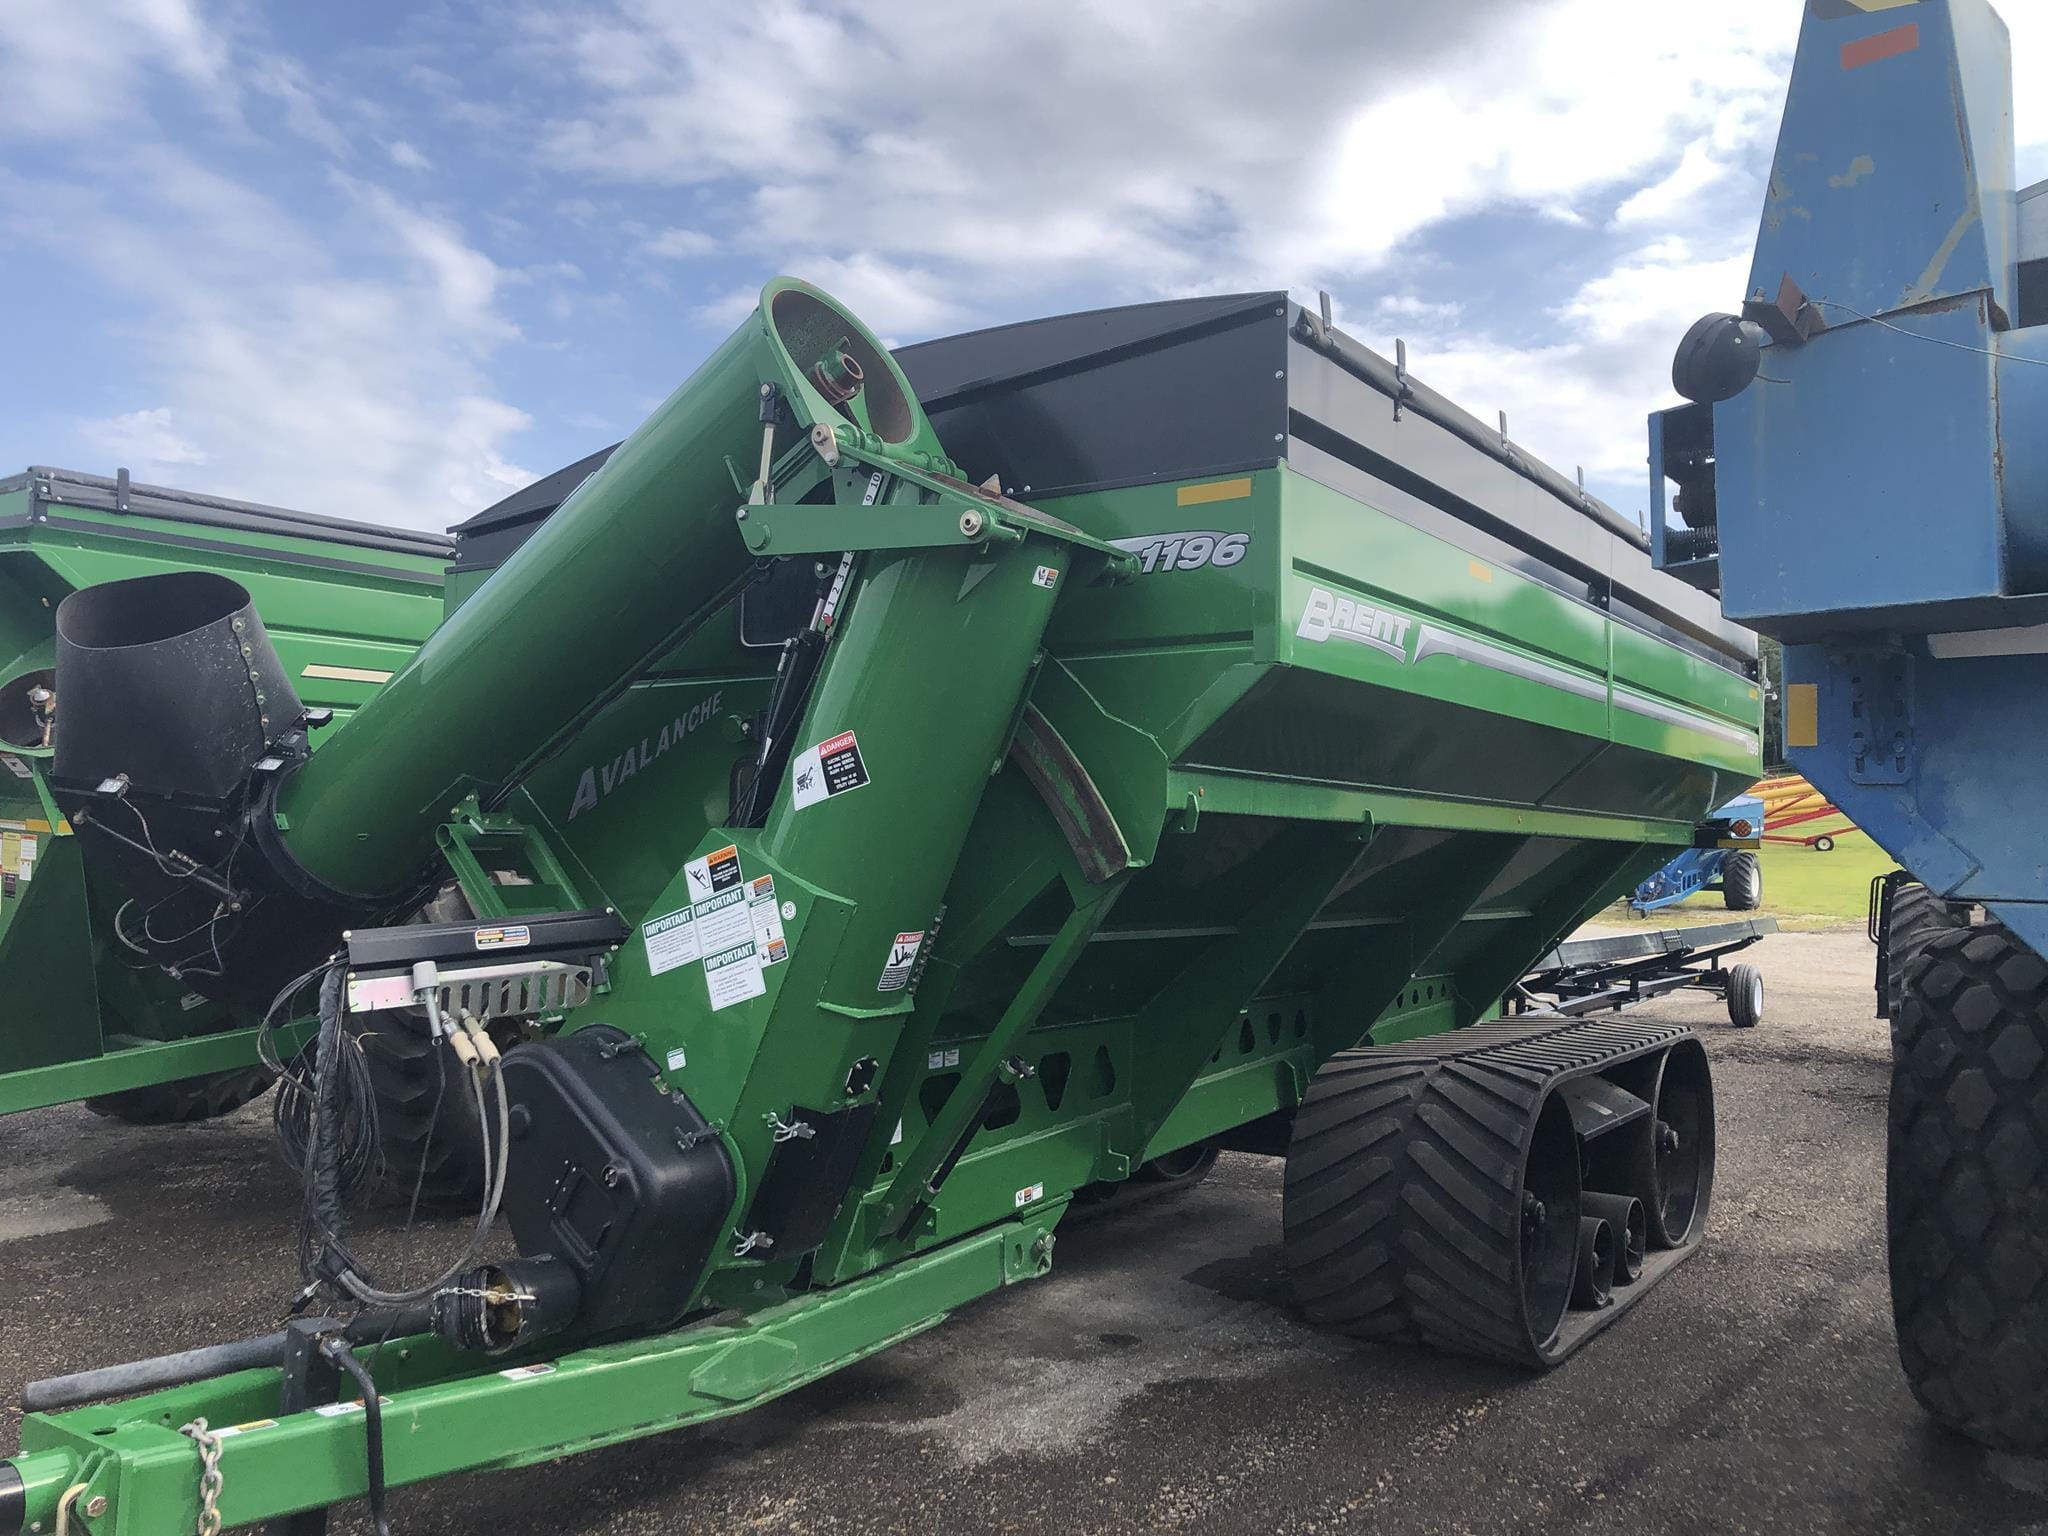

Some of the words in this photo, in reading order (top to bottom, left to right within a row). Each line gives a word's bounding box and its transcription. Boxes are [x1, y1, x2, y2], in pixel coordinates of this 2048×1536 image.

[871, 474, 880, 488] 10
[1141, 532, 1250, 575] 1196
[832, 586, 840, 594] 2
[837, 574, 844, 582] 3
[842, 560, 849, 568] 4
[1296, 587, 1412, 650] BRENT
[567, 690, 723, 823] AVALANCHE
[826, 735, 855, 751] DANGER
[695, 889, 742, 917] IMPORTANT
[645, 910, 691, 937] IMPORTANT
[706, 943, 753, 970] IMPORTANT
